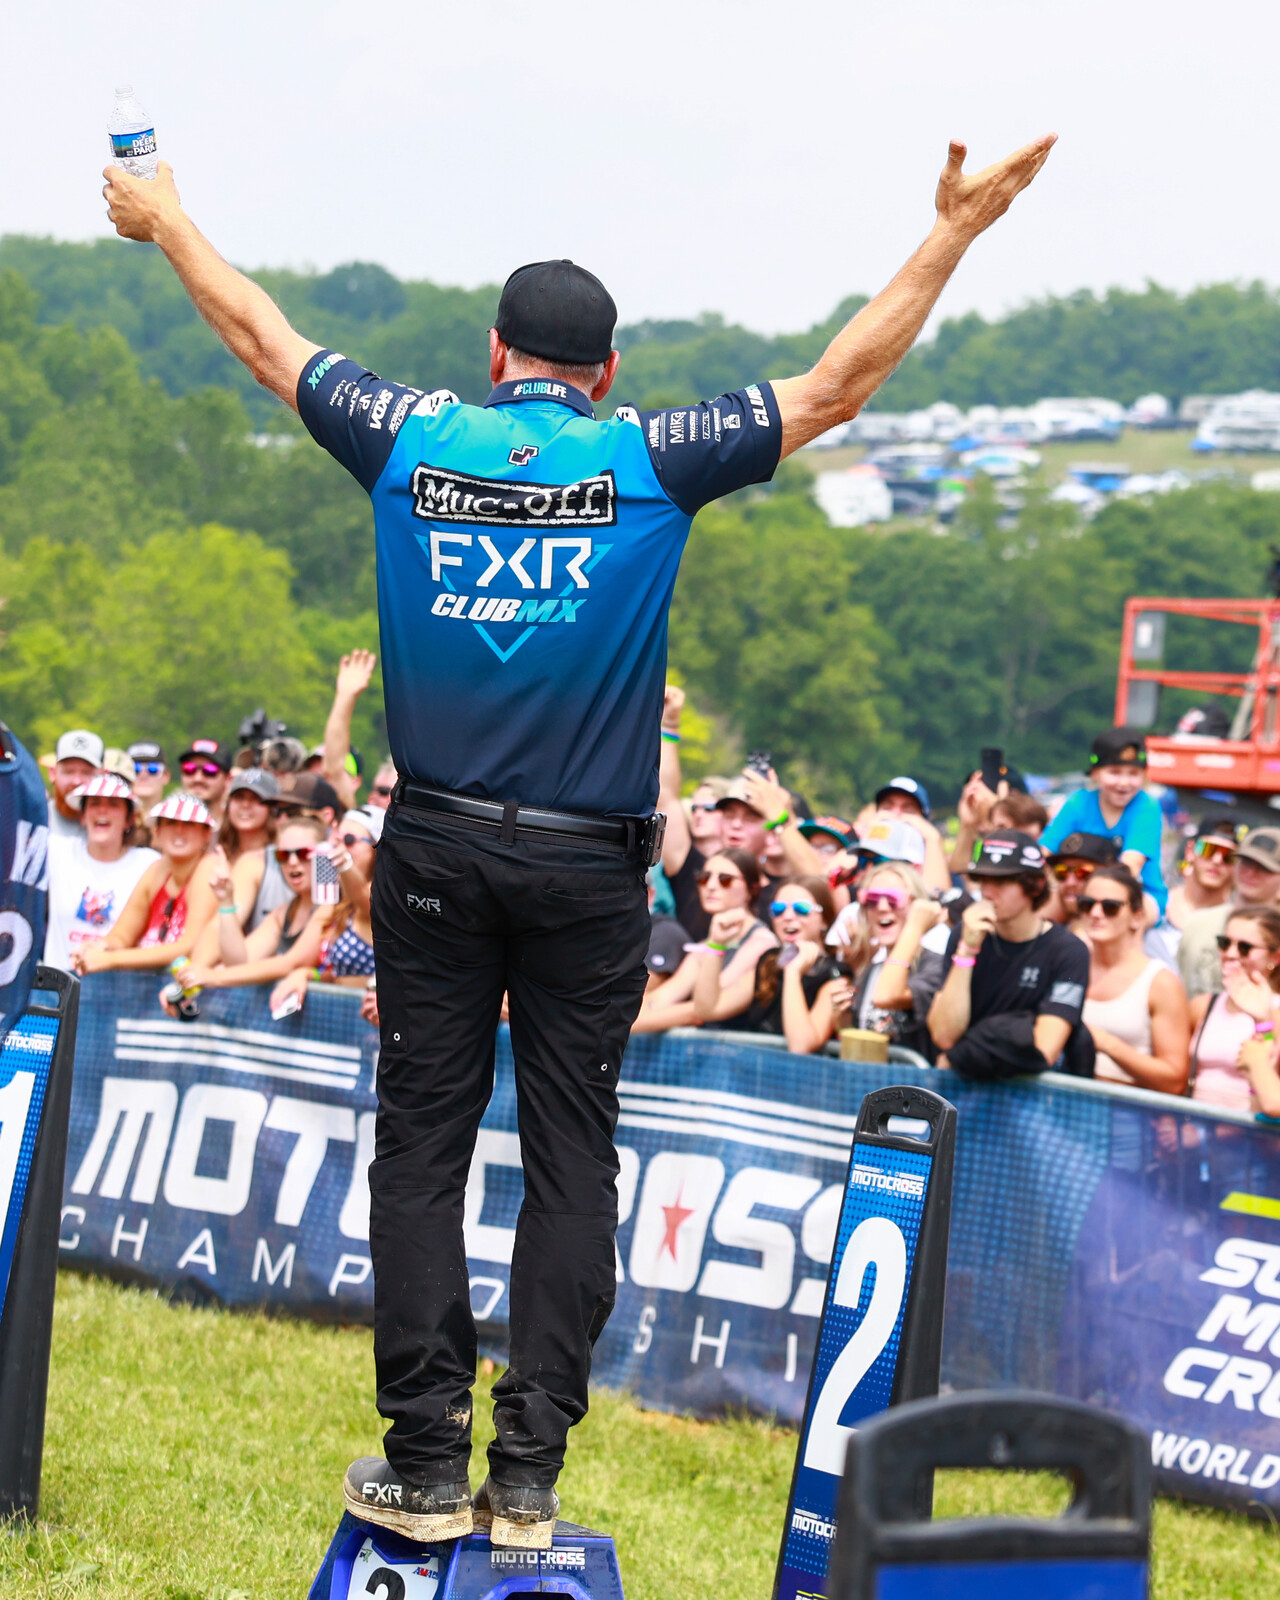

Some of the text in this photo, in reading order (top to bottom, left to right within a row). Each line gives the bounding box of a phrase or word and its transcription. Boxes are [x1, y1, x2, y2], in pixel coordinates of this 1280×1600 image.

[132, 135, 154, 147] DEER
[133, 143, 155, 156] PARK
[513, 382, 567, 398] #CLUBLIFE
[424, 478, 604, 516] Muc-Off
[430, 531, 592, 589] FXR
[430, 593, 588, 622] CLUBMX
[407, 893, 441, 912] FXR
[4, 1036, 54, 1051] OTOCROSS
[850, 1183, 922, 1201] CHAMPIONSHIP
[851, 1169, 925, 1196] MOTOCROSS
[803, 1217, 907, 1476] 2
[1151, 1429, 1280, 1489] WORLD
[361, 1481, 403, 1505] FXR
[792, 1514, 838, 1540] MOTOCR
[490, 1550, 585, 1566] MOTOCROSS
[490, 1563, 586, 1571] CHAMPIONSHIP
